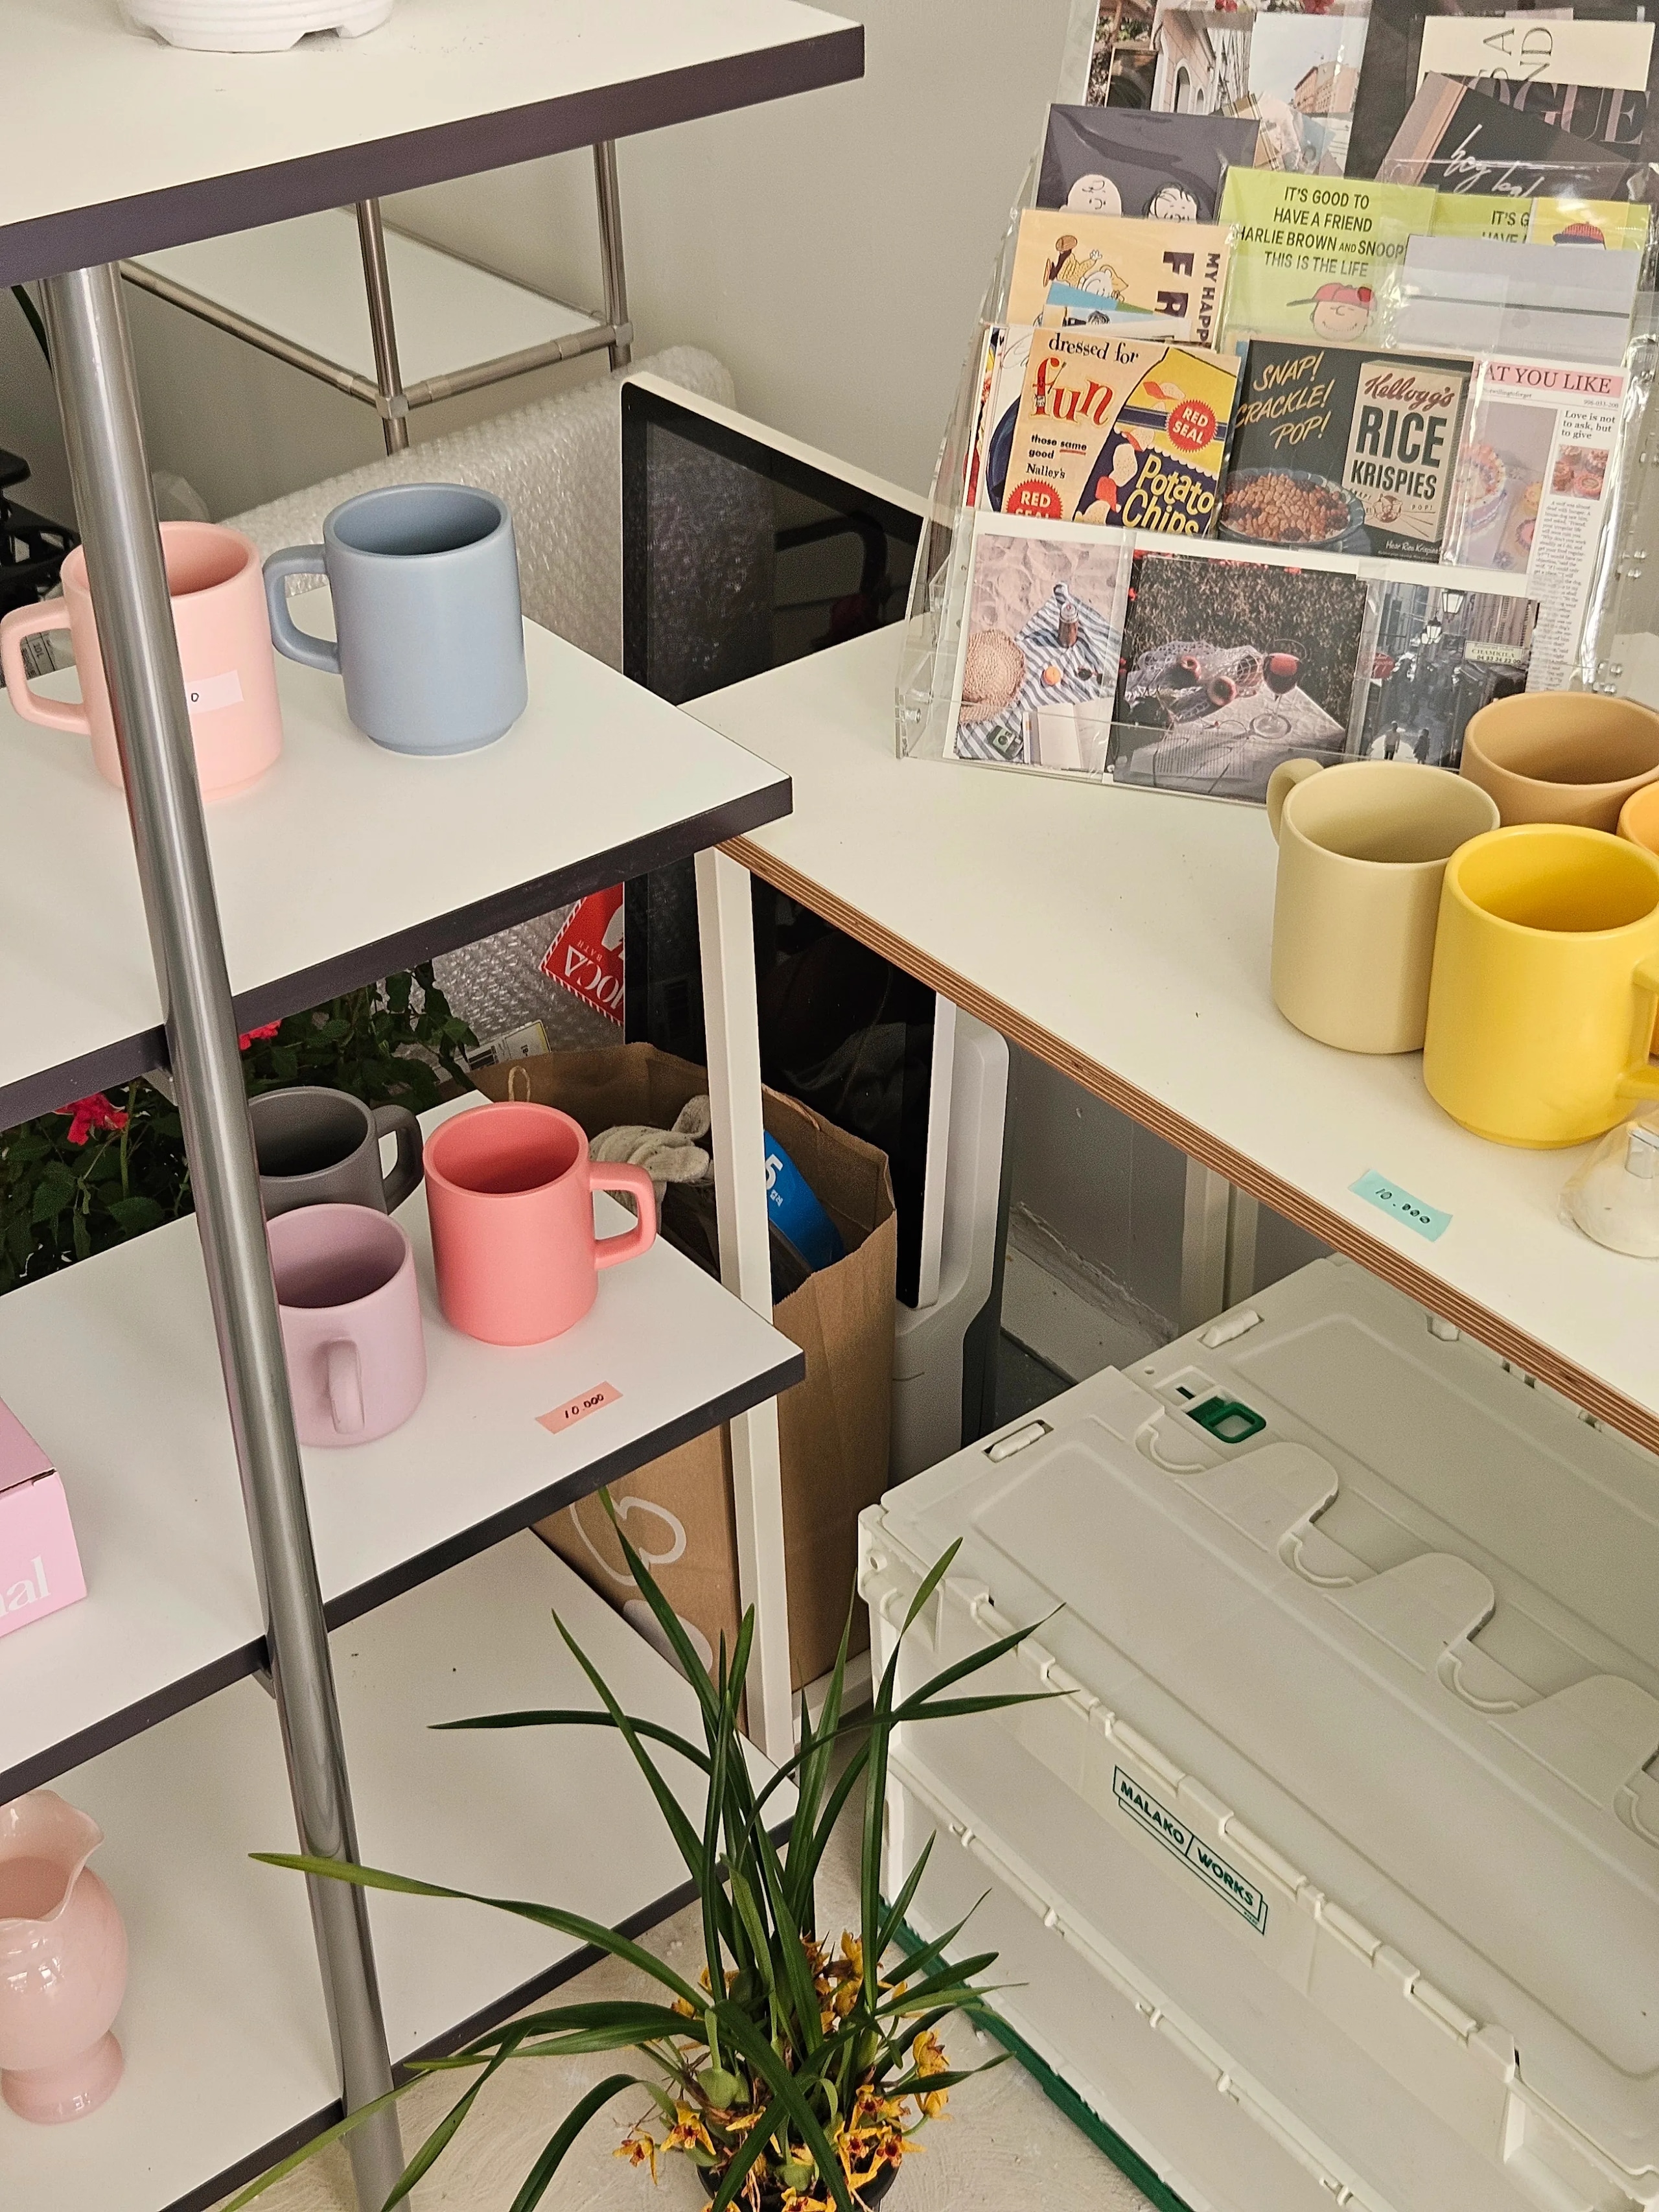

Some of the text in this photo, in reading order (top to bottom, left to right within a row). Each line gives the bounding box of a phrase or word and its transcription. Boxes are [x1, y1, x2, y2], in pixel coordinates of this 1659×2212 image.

[1284, 186, 1369, 210] IT'S GOOD TO
[1273, 207, 1373, 232] HAVE A FRIEND
[1491, 210, 1516, 226] IT'S
[1234, 226, 1284, 245] HARLIE
[1286, 232, 1338, 251] BROWN
[1338, 242, 1356, 253] AND
[1205, 252, 1221, 283] MY
[1264, 251, 1369, 277] THIS IS THE LIFE
[1049, 332, 1109, 360] dressed
[1114, 342, 1139, 364] for
[1253, 350, 1324, 391] SNAP!
[1515, 368, 1559, 387] YOU
[1563, 374, 1612, 394] LIKE
[1032, 357, 1113, 425] fun
[1235, 378, 1335, 428] CRACKLE!
[1365, 373, 1455, 412] Kellogg's
[1182, 407, 1209, 427] RED
[1565, 410, 1587, 420] Love
[1589, 413, 1597, 421] is
[1575, 421, 1593, 431] ask,
[1595, 423, 1611, 432] but
[1031, 434, 1057, 446] those
[1172, 421, 1204, 445] SEAL
[1270, 410, 1331, 450] POP!
[1355, 404, 1448, 469] RICE
[1572, 430, 1592, 439] give
[1028, 449, 1054, 459] good
[1136, 453, 1215, 517] Potato
[1351, 459, 1437, 500] KRISPIES
[1020, 491, 1051, 508] RED
[577, 940, 603, 962] BATH
[1120, 1780, 1254, 1907] MALAKO WORKS
